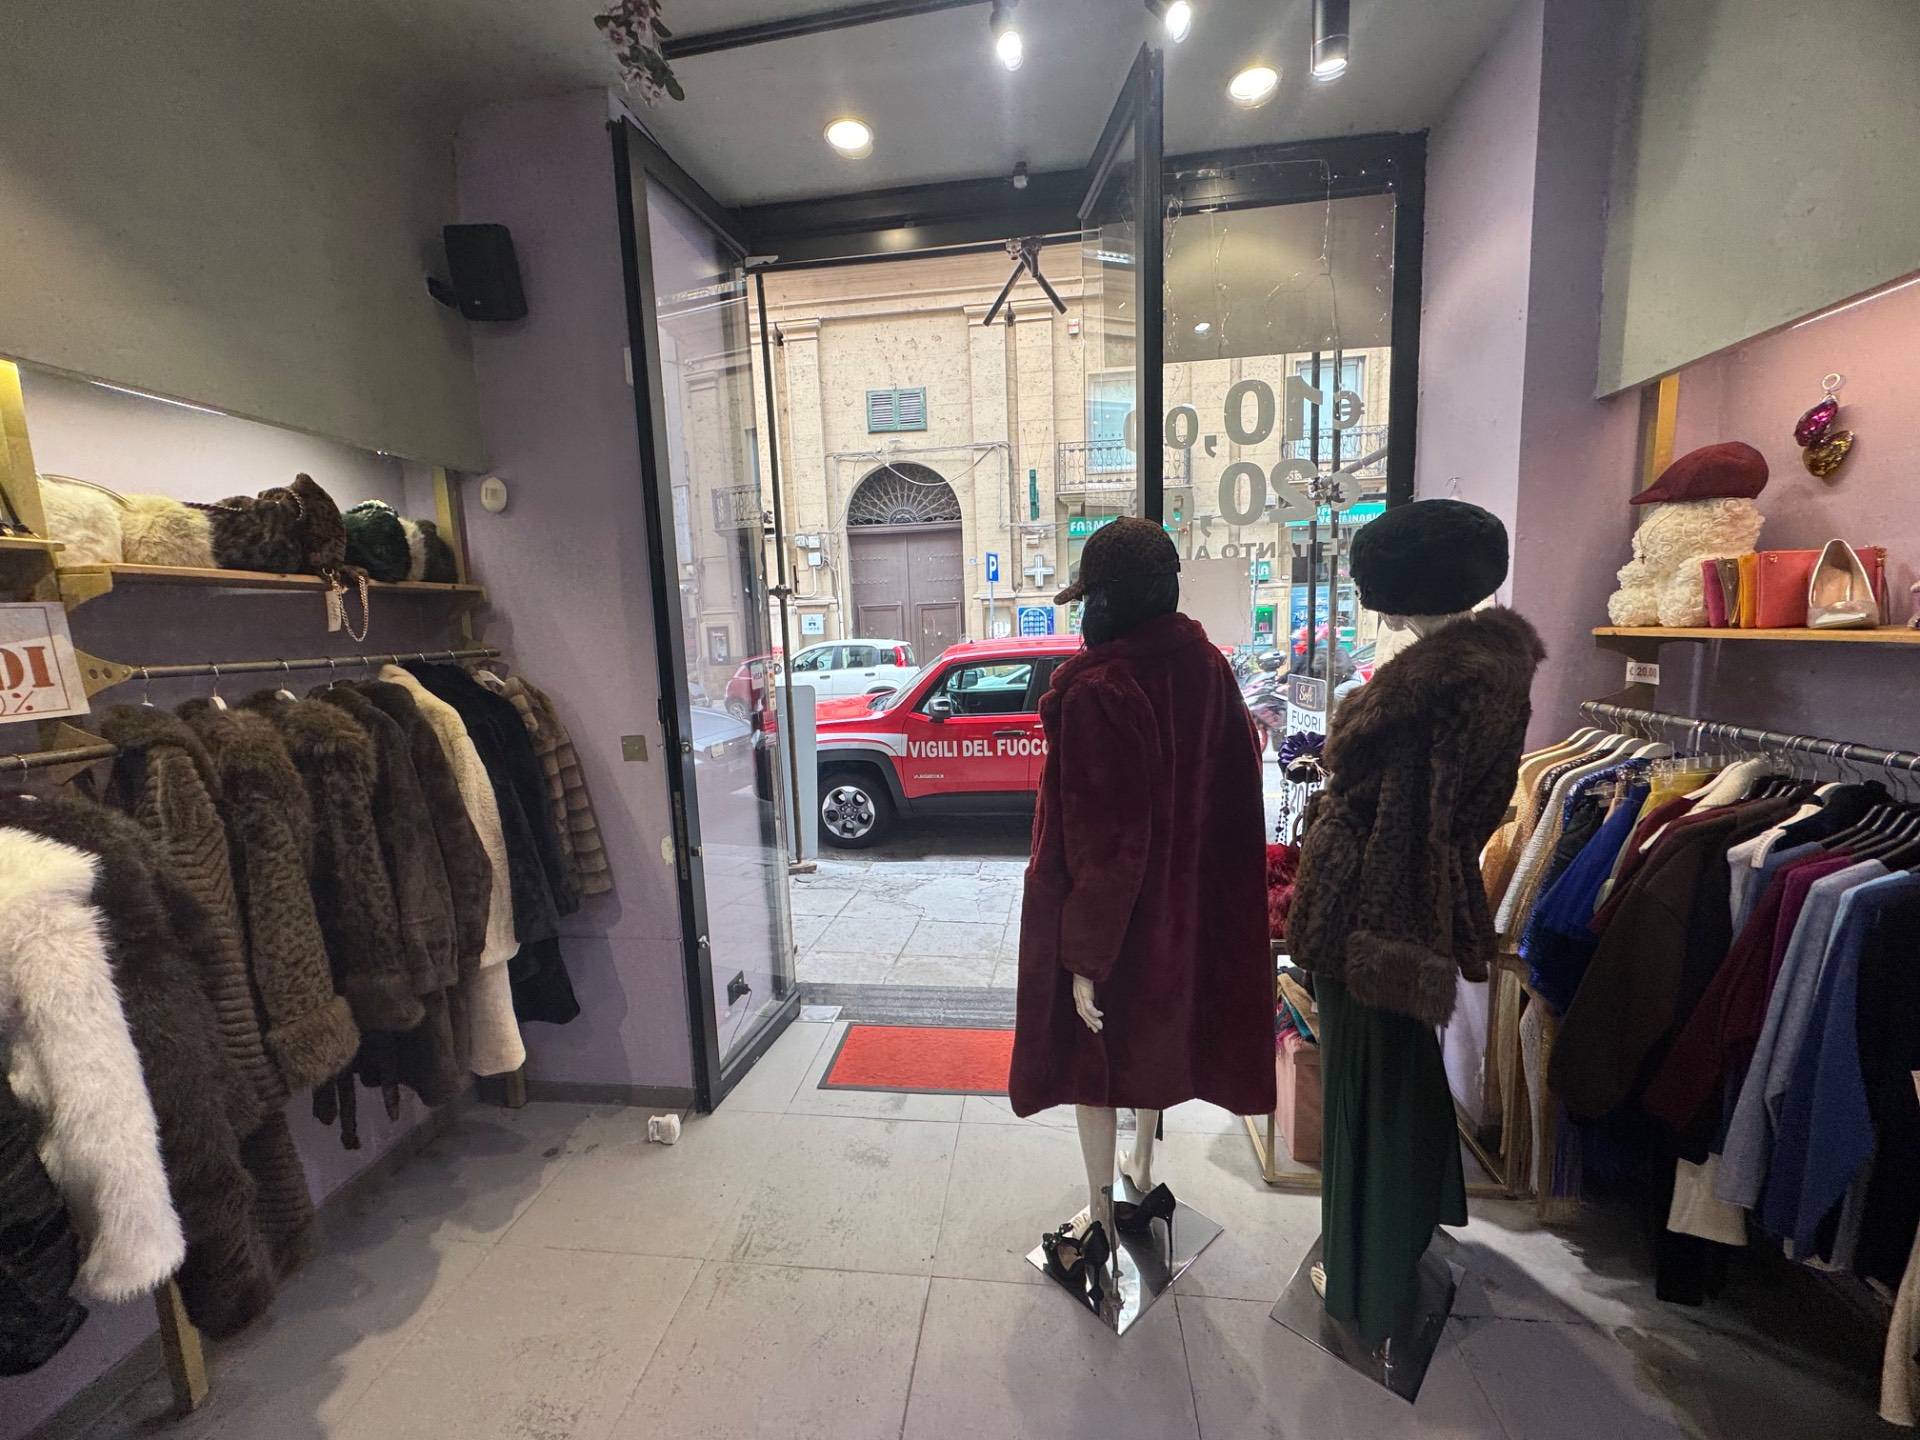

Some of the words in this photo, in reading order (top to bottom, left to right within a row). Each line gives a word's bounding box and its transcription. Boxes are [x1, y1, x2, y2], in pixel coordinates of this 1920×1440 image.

[989, 556, 996, 579] P
[1291, 709, 1321, 732] FUORI
[908, 740, 958, 758] VIGILI
[962, 739, 993, 757] DEL
